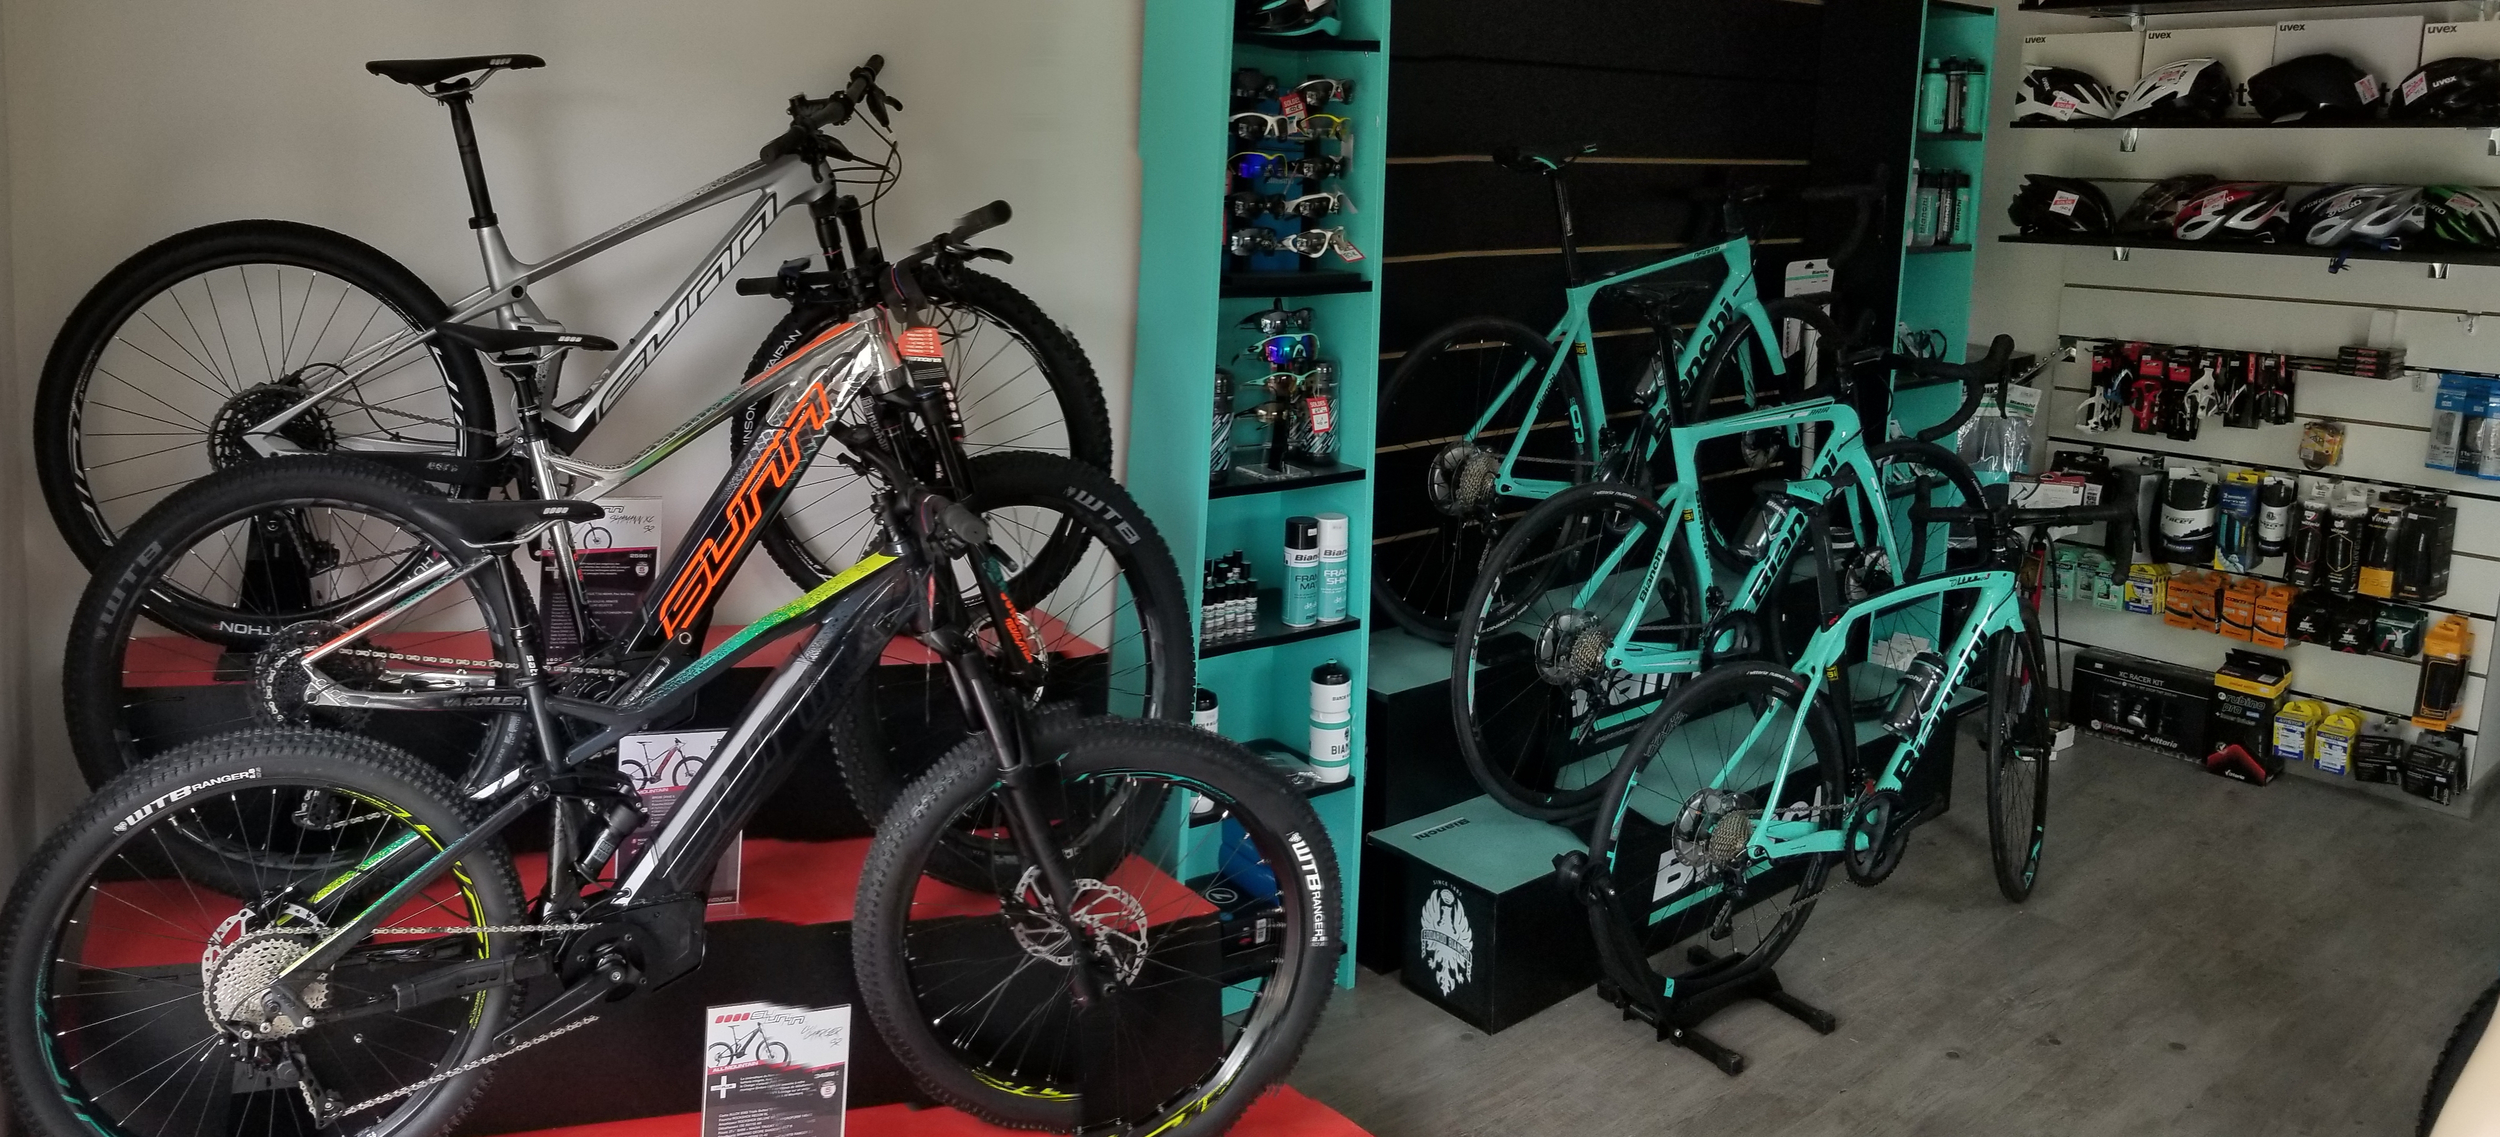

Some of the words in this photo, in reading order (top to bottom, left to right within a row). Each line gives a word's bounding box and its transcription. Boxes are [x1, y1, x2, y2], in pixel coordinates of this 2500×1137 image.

[2280, 23, 2306, 32] uvex
[2427, 25, 2457, 33] uvex
[2148, 31, 2171, 39] uvex
[2432, 75, 2457, 88] uvex
[596, 191, 777, 424] SUNN
[763, 329, 803, 373] TAIPAN
[2010, 400, 2036, 409] Bianchi
[659, 382, 831, 640] SUNN
[1073, 489, 1142, 545] WTB
[1638, 547, 1664, 603] Bianchi
[2225, 596, 2247, 605] CONTI
[2256, 604, 2279, 613] CONTI
[218, 620, 275, 637] THON
[2129, 673, 2151, 684] RACER
[2152, 679, 2165, 687] KIT
[462, 696, 522, 707] ROULER
[2226, 691, 2267, 710] rubino
[2222, 702, 2243, 715] pro
[2104, 723, 2135, 735] GRAPHENE
[2149, 735, 2178, 749] vittoria
[123, 785, 193, 828] WTB
[192, 772, 251, 793] RANGER
[1415, 815, 1470, 841] Bianchi
[1291, 840, 1325, 891] WTB
[1309, 889, 1327, 937] RANGER
